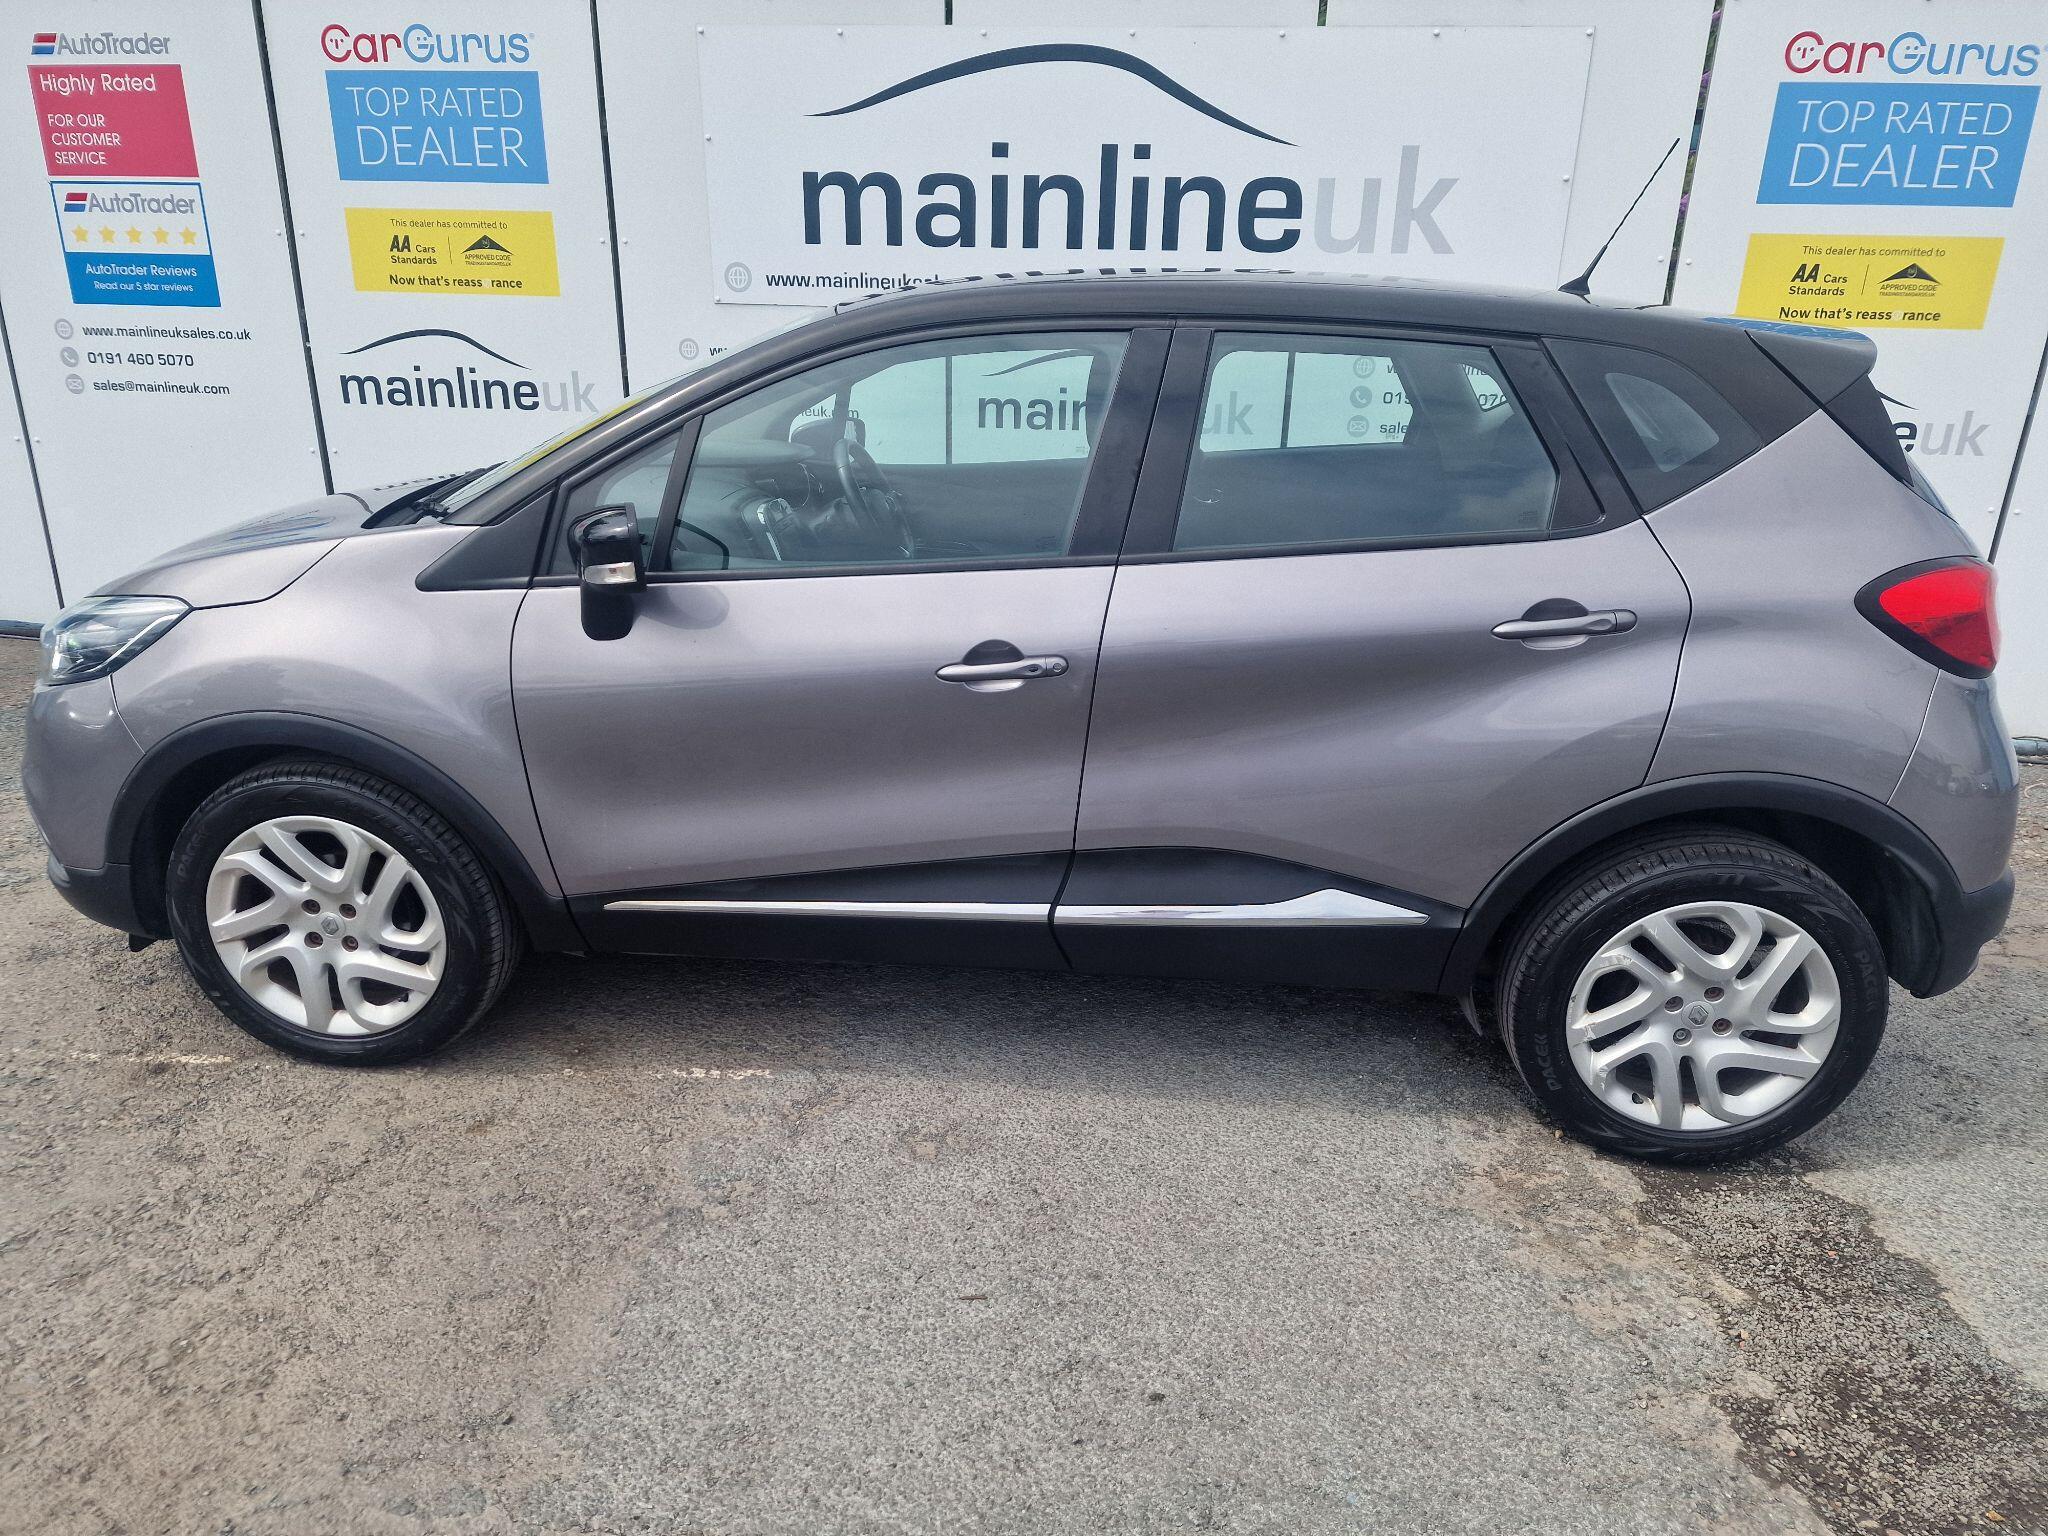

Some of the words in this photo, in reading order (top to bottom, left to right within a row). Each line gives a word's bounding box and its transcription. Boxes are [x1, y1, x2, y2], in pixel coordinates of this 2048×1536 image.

[57, 32, 170, 55] AutoTrader
[321, 24, 530, 63] CarGurus
[1784, 31, 2041, 76] CarGurus
[40, 74, 95, 96] Highly
[101, 74, 156, 92] Rated
[346, 87, 410, 117] TOP
[420, 88, 523, 118] RATED
[48, 114, 74, 126] FOR
[77, 114, 105, 128] OUR
[1798, 100, 1876, 134] TOP
[1885, 101, 2013, 136] RATED
[52, 133, 121, 146] CUSTOMER
[356, 125, 528, 168] DEALER
[55, 151, 107, 165] SERVICE
[1789, 143, 1999, 190] DEALER
[88, 193, 195, 214] AutoTrader
[802, 141, 1460, 255] mainlineuk
[390, 219, 407, 227] This
[409, 219, 435, 228] dealer
[436, 220, 451, 229] has
[453, 221, 497, 229] committed
[499, 222, 508, 230] to
[390, 235, 411, 252] AA
[416, 245, 436, 253] Cars
[1802, 246, 1823, 255] This
[1825, 246, 1857, 256] dealer
[1859, 247, 1876, 256] has
[1879, 247, 1933, 257] committed
[1936, 248, 1946, 257] to
[390, 255, 437, 265] Standards
[86, 264, 147, 276] AutoTrader
[150, 265, 197, 277] Reviews
[1791, 263, 1820, 282] AA
[1823, 274, 1848, 283] Cars
[94, 281, 118, 290] Read
[119, 283, 135, 291] our
[136, 282, 142, 291] 5
[143, 282, 160, 291] star
[161, 283, 194, 292] reviews
[389, 274, 416, 285] Now
[418, 276, 450, 287] that's
[1789, 286, 1845, 296] Standards
[1779, 307, 1811, 319] Now
[1814, 307, 1852, 319] that's
[82, 326, 252, 340] www.mainlineuksales.co.uk
[88, 352, 122, 364] 0191
[127, 353, 154, 365] 460
[158, 354, 194, 366] 5070
[93, 380, 230, 394] sales@mainlineuk.com
[339, 366, 600, 414] mainlineuk
